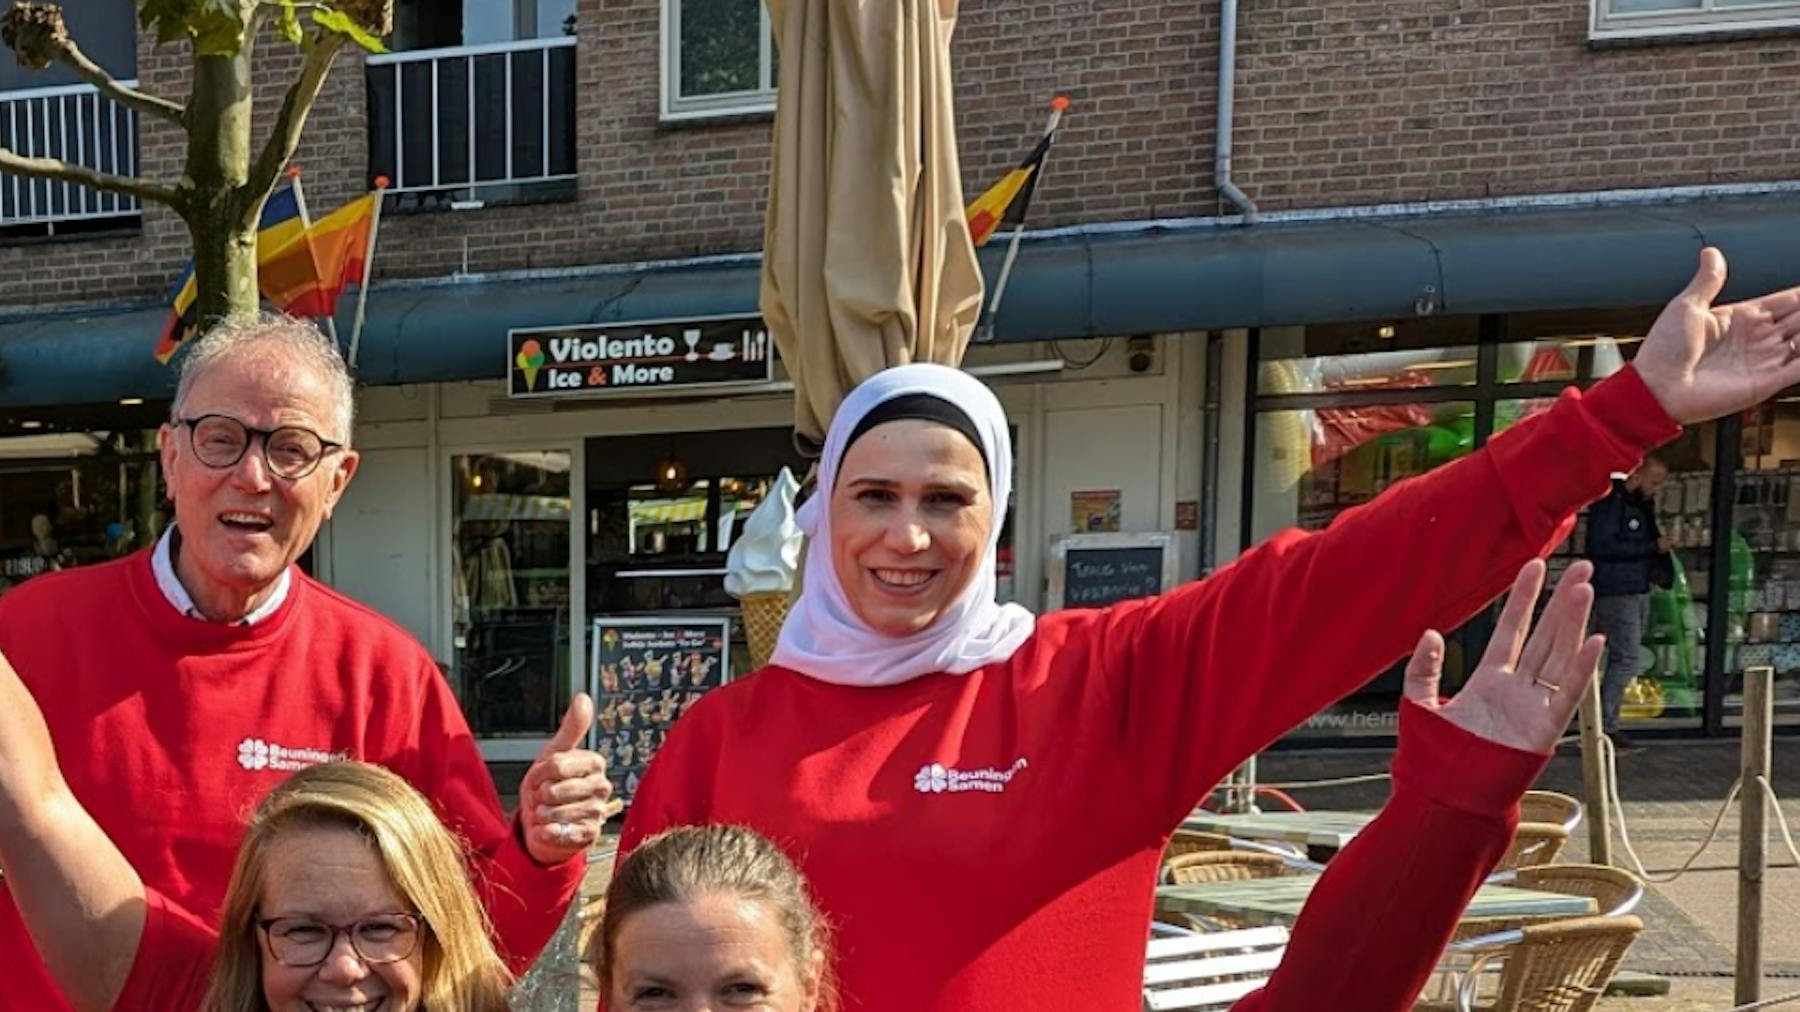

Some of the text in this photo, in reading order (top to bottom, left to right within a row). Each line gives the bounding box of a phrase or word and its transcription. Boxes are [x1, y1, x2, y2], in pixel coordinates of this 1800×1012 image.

[549, 333, 676, 362] Violento
[549, 365, 675, 389] Ice & More
[947, 779, 1005, 793] Samen
